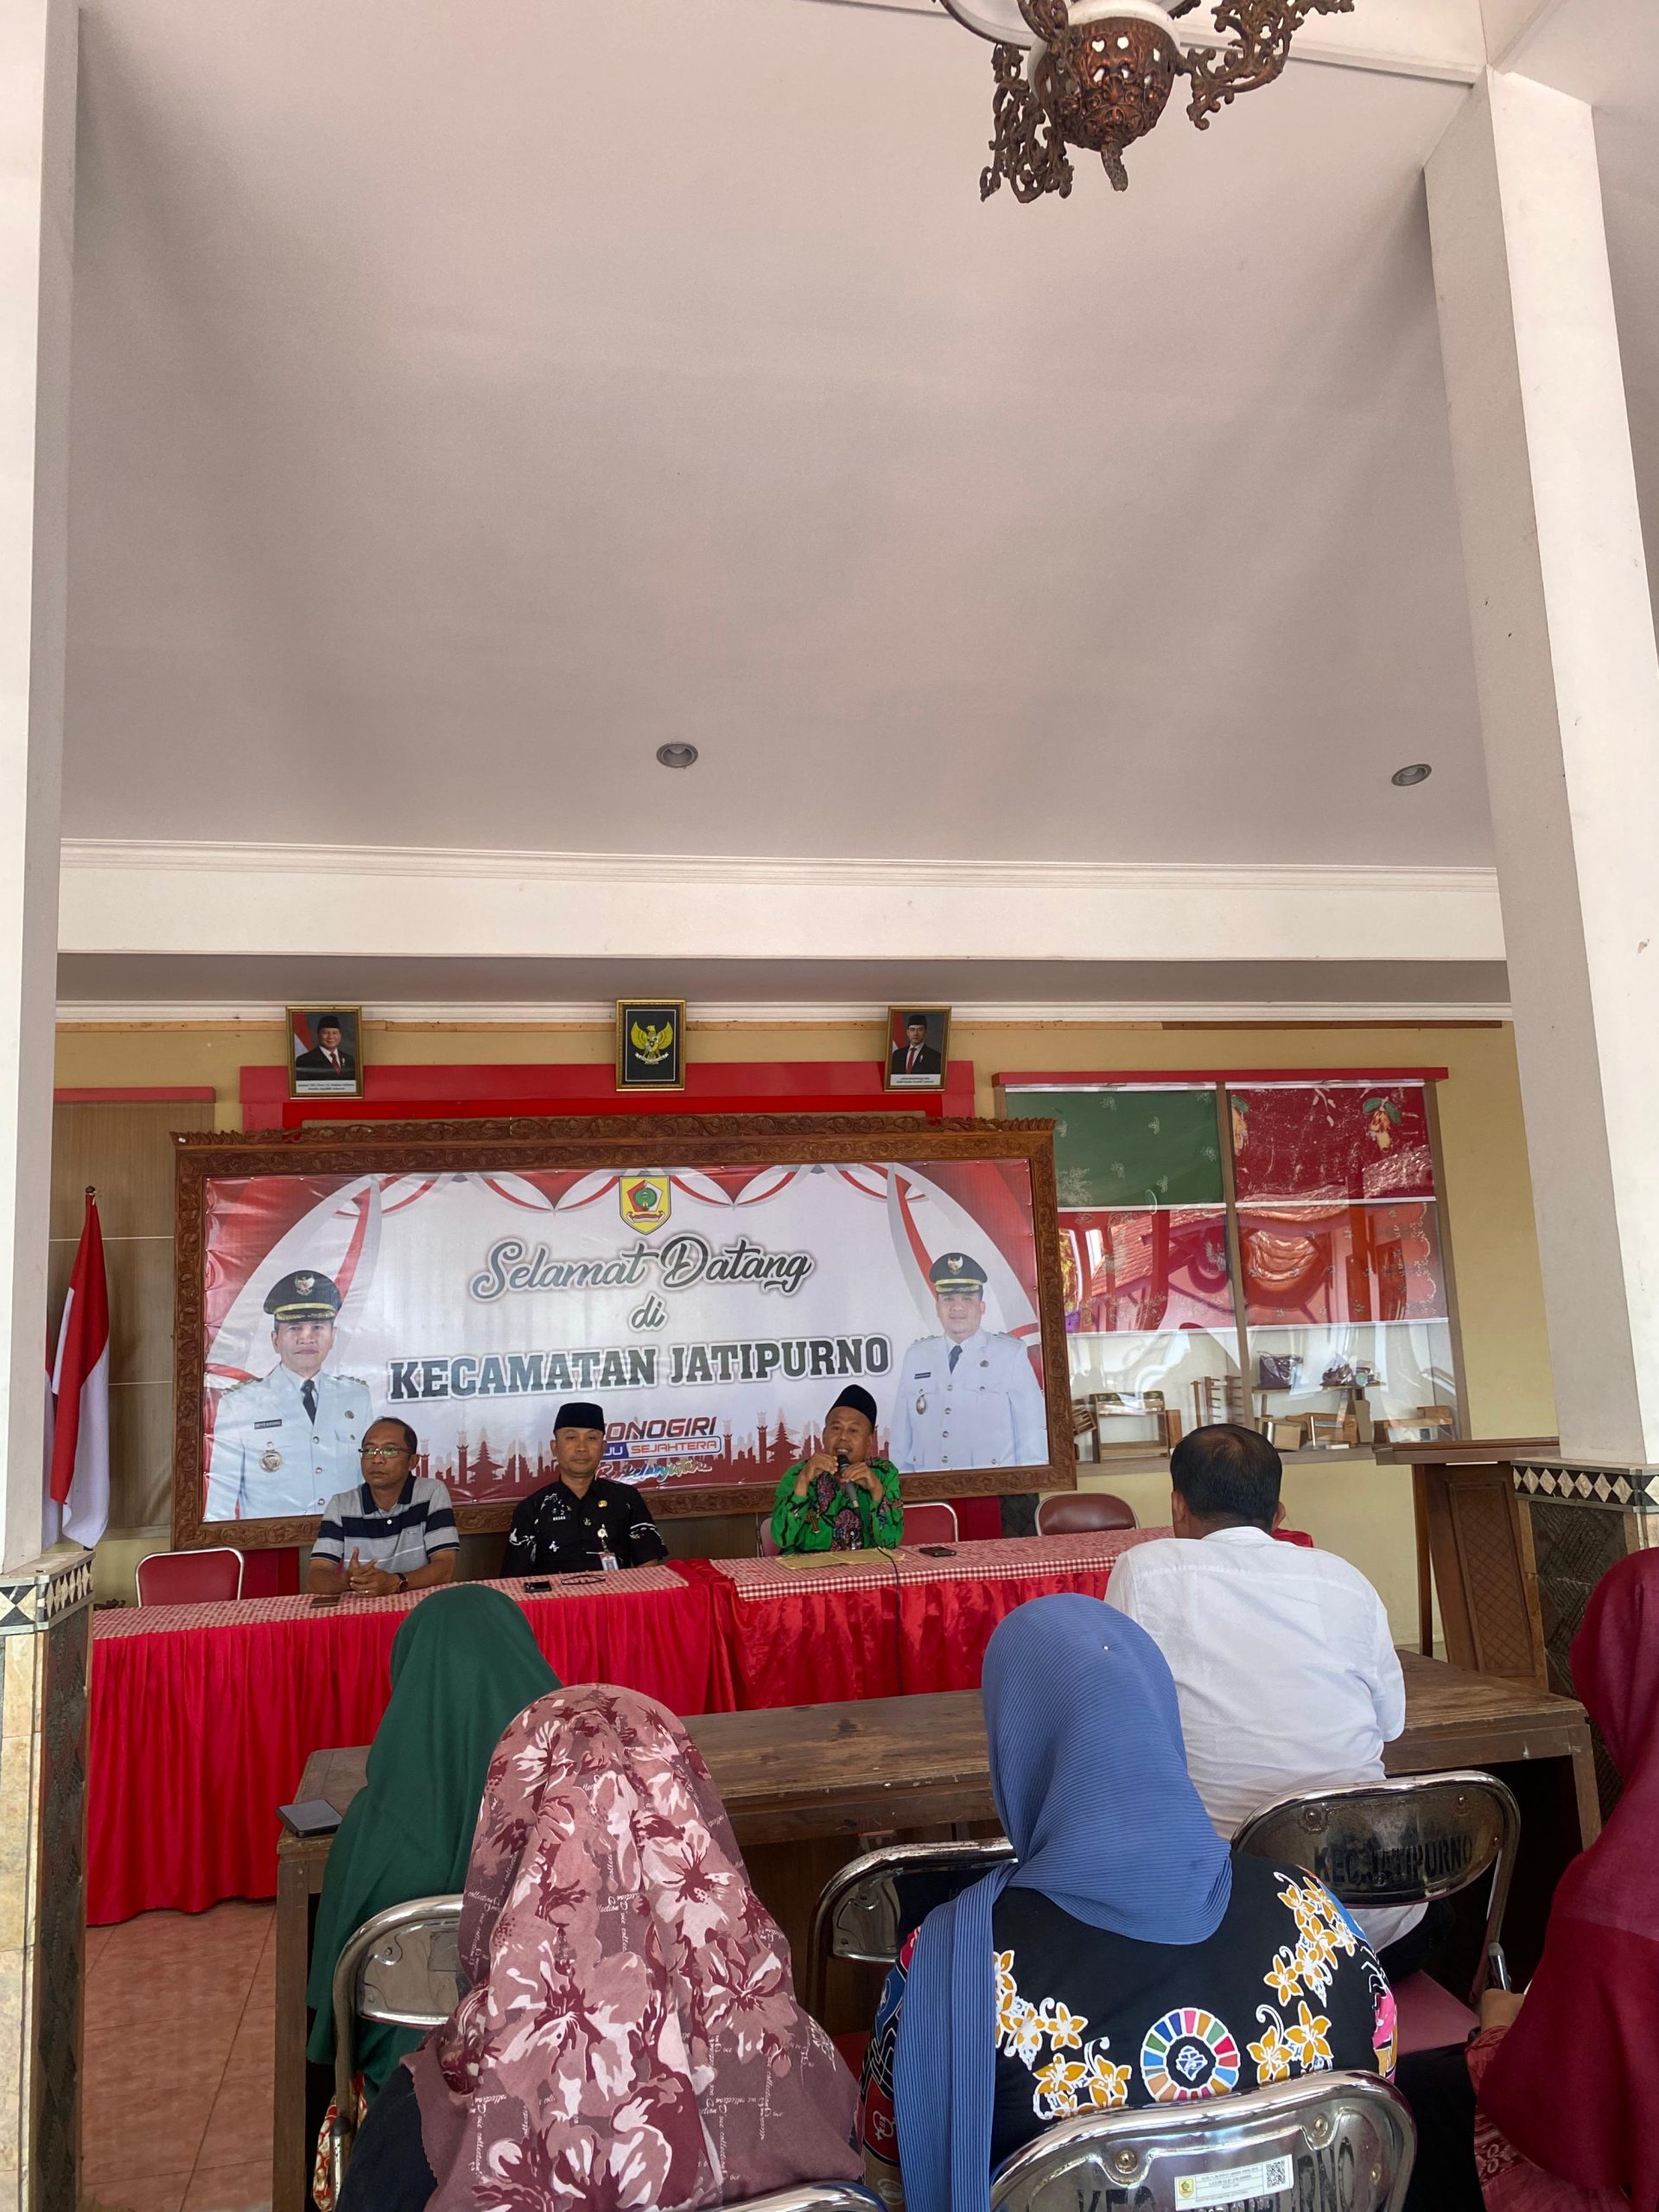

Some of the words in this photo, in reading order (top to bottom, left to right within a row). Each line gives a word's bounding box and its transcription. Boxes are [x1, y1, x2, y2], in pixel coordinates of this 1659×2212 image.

[472, 1240, 659, 1298] Selamat
[660, 1236, 812, 1294] Datang
[631, 1295, 665, 1329] di
[391, 1349, 658, 1399] KECAMATAN
[671, 1337, 888, 1383] JATIPURNO
[604, 1416, 716, 1441] ONOGIRI
[603, 1446, 623, 1456] JU
[631, 1440, 716, 1454] SEJAHTERA
